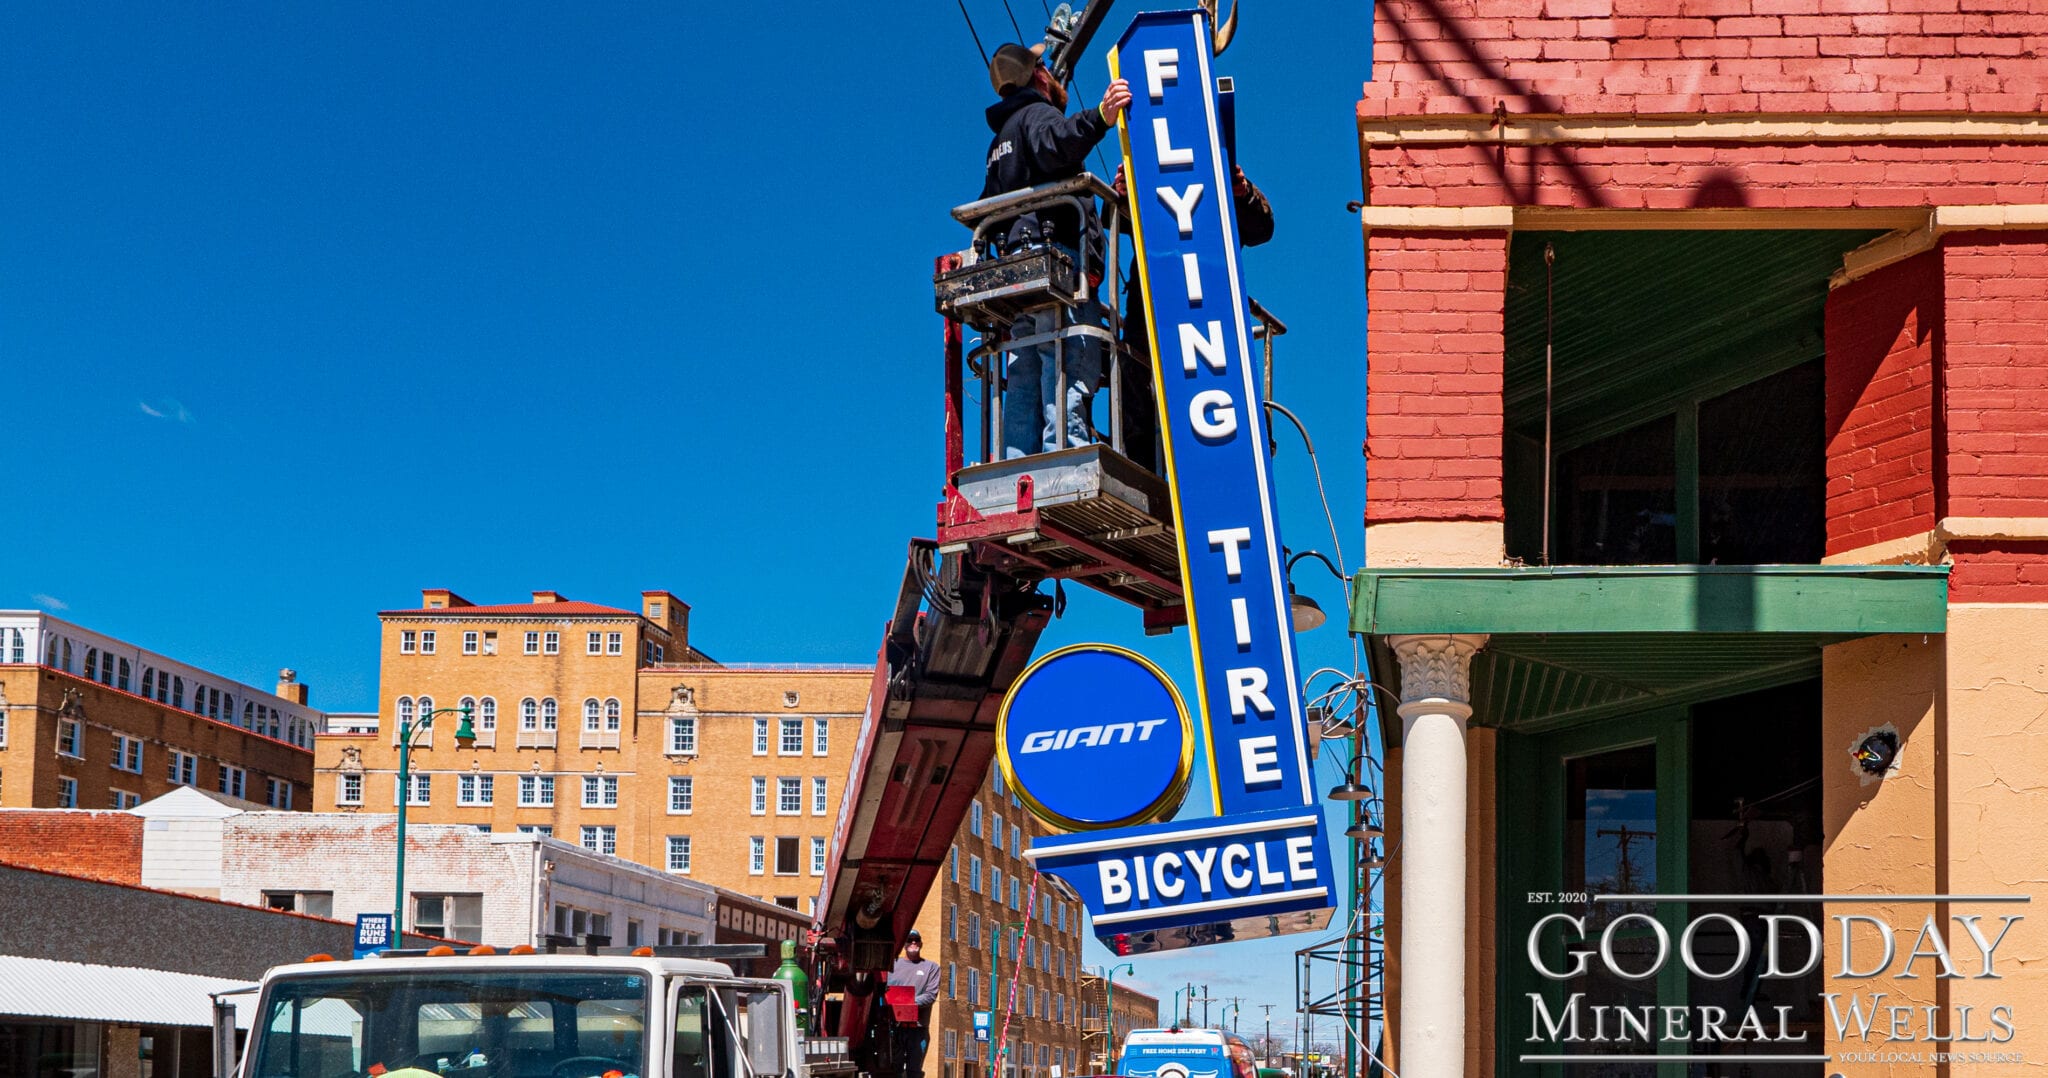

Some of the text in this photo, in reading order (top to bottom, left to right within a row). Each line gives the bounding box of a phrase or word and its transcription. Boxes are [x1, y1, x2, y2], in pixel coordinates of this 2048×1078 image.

[1144, 48, 1283, 784] FLYING TIRE
[1020, 718, 1168, 754] GIANT
[1098, 836, 1318, 905] BICYCLE
[359, 936, 386, 944] DEEP.
[360, 929, 386, 937] RUNS
